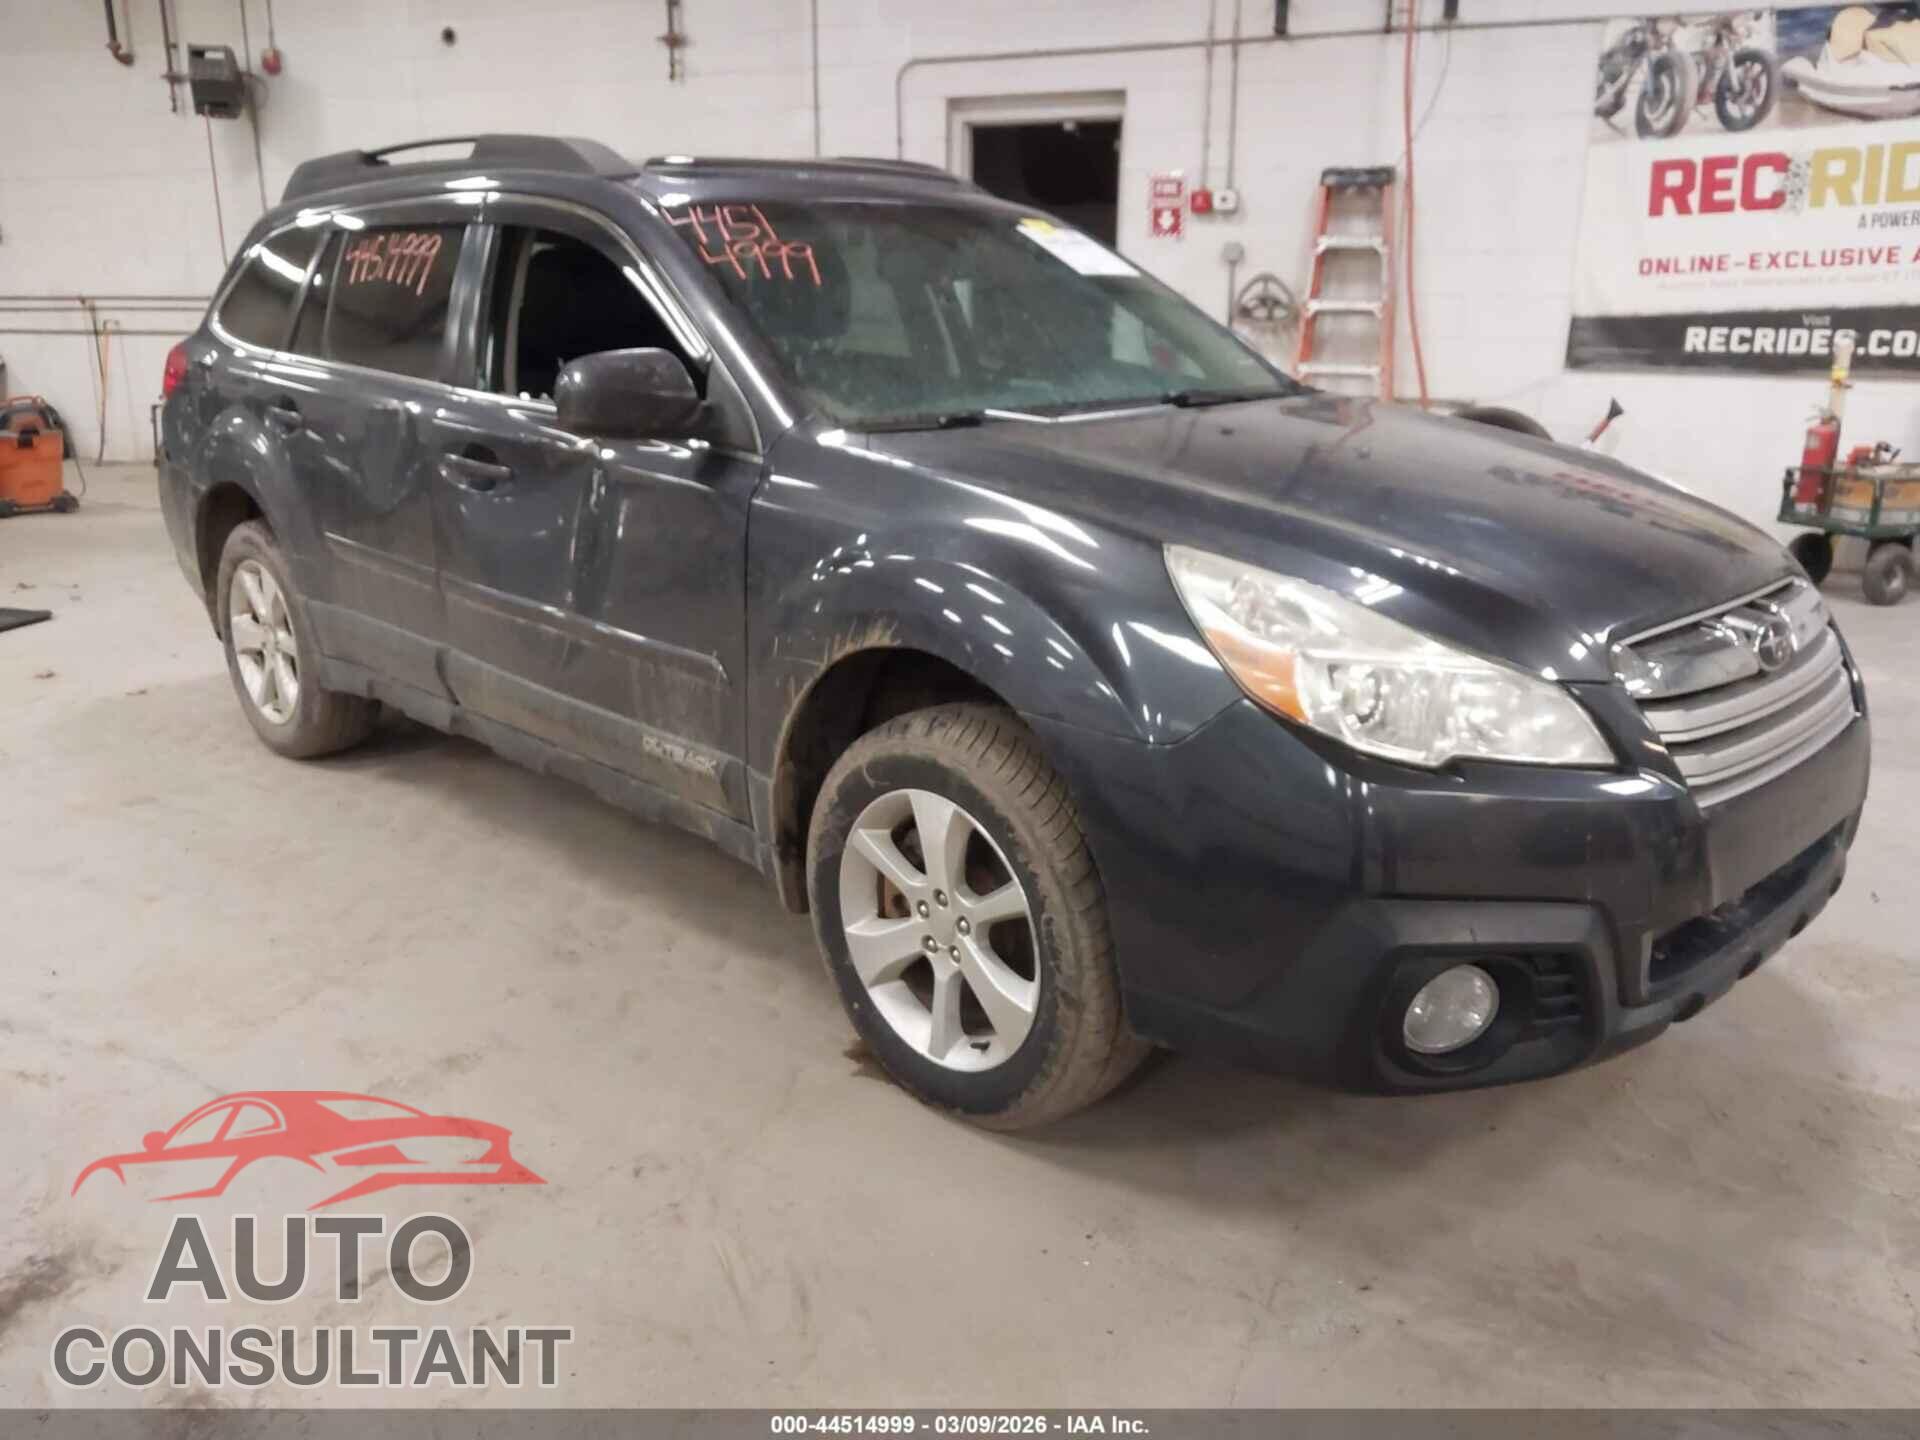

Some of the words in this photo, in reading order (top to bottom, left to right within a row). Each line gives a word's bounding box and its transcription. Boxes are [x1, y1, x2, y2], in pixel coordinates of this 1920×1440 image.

[660, 203, 778, 243] 4451
[1857, 212, 1867, 229] A
[699, 239, 822, 286] 4999
[1639, 247, 1901, 275] ONLINE-EXCLUSIVE
[1684, 326, 1920, 356] RECRIDES.CO
